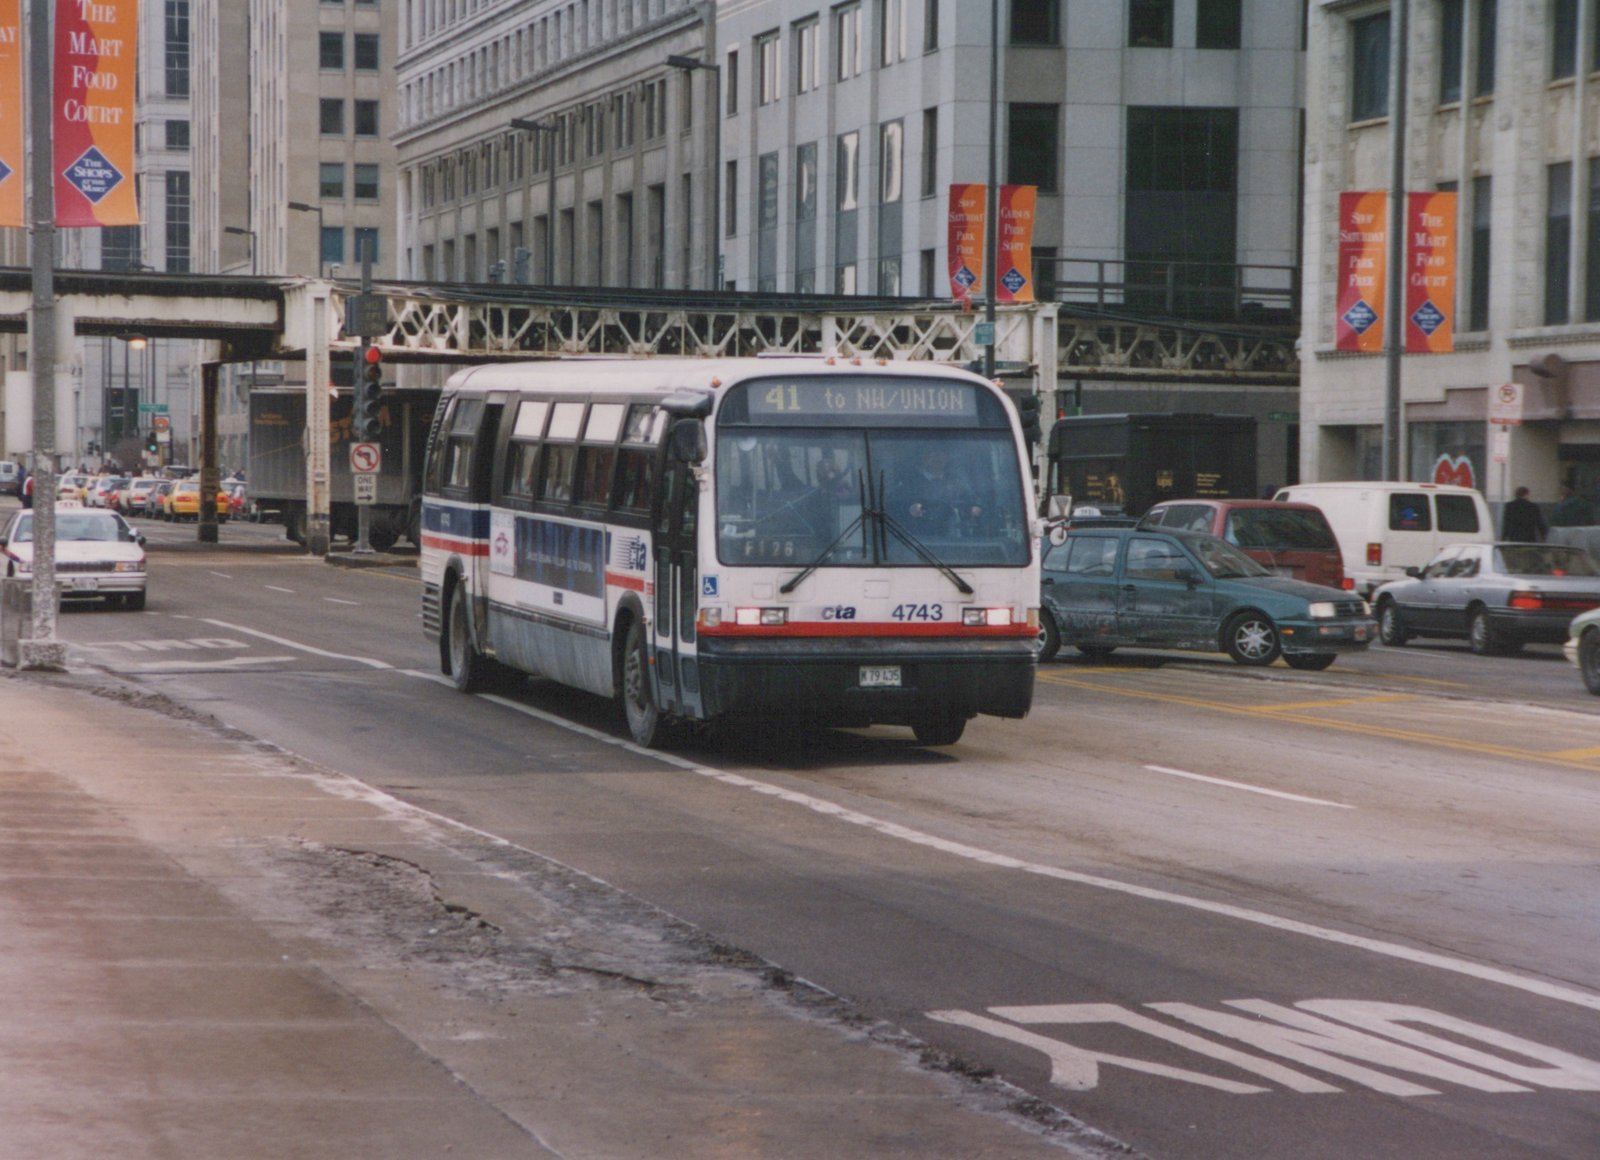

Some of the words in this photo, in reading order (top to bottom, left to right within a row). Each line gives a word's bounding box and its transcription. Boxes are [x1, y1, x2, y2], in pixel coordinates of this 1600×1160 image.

[77, 0, 116, 23] THE
[68, 31, 123, 57] MART
[72, 65, 117, 90] FOOD
[64, 99, 123, 124] COURT
[74, 166, 113, 179] SHOPS
[1419, 213, 1445, 228] THE
[1415, 232, 1448, 248] MART
[766, 384, 801, 411] 41
[824, 387, 846, 410] to
[857, 388, 964, 411] NW/UNION
[821, 605, 856, 620] cta
[892, 604, 943, 621] 4743
[870, 670, 880, 681] 79
